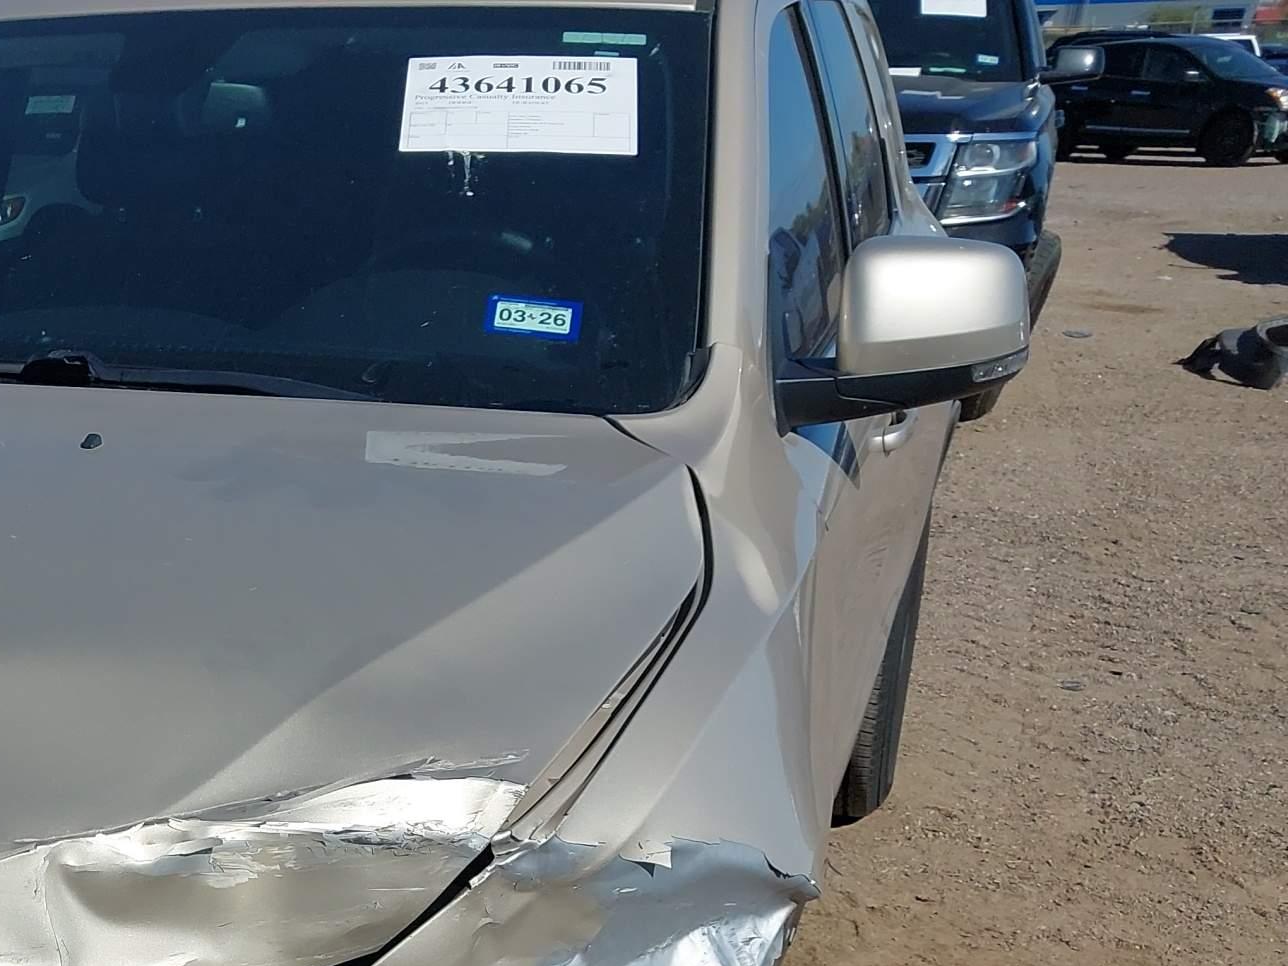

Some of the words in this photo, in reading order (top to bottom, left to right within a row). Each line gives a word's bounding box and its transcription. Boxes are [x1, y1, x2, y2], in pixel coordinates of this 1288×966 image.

[428, 76, 609, 94] 43641065
[499, 308, 527, 323] 03
[537, 312, 567, 327] 26
